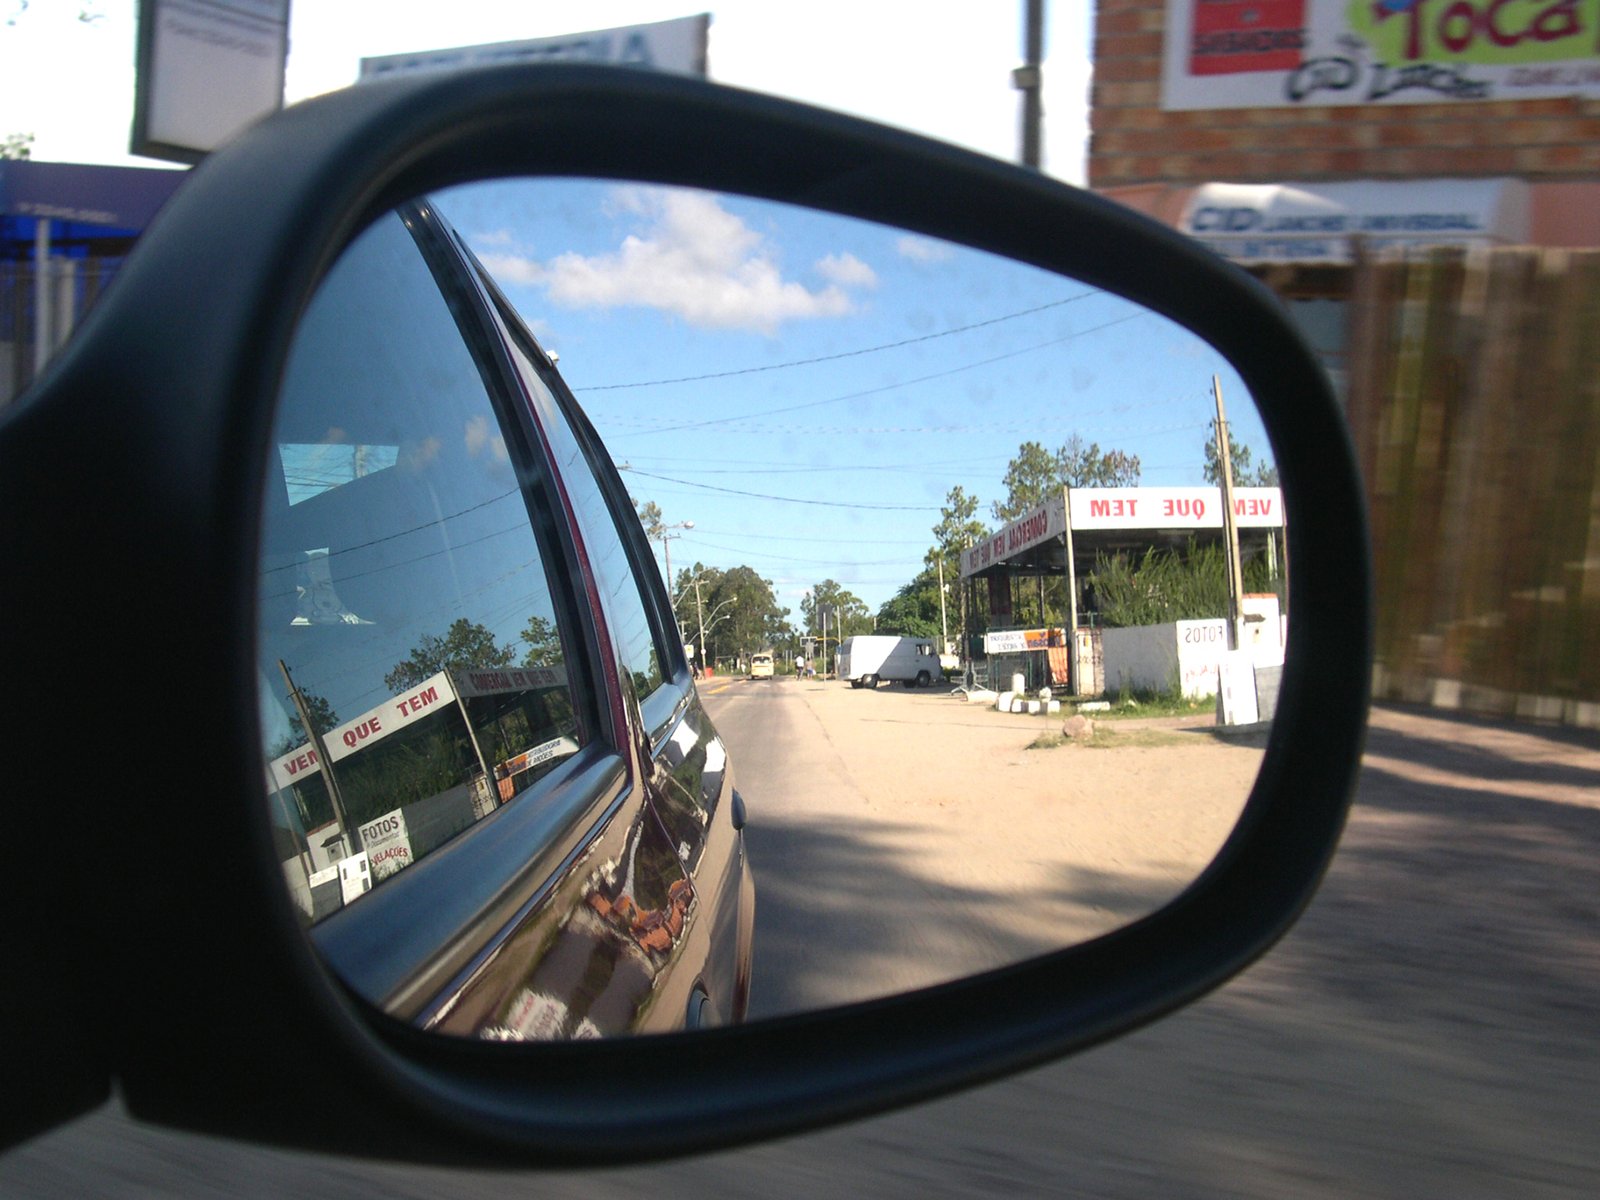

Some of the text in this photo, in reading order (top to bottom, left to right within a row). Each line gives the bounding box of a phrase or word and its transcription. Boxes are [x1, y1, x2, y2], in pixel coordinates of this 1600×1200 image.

[342, 717, 382, 748] QUE
[396, 686, 439, 718] TEM
[361, 816, 399, 843] FOTOS
